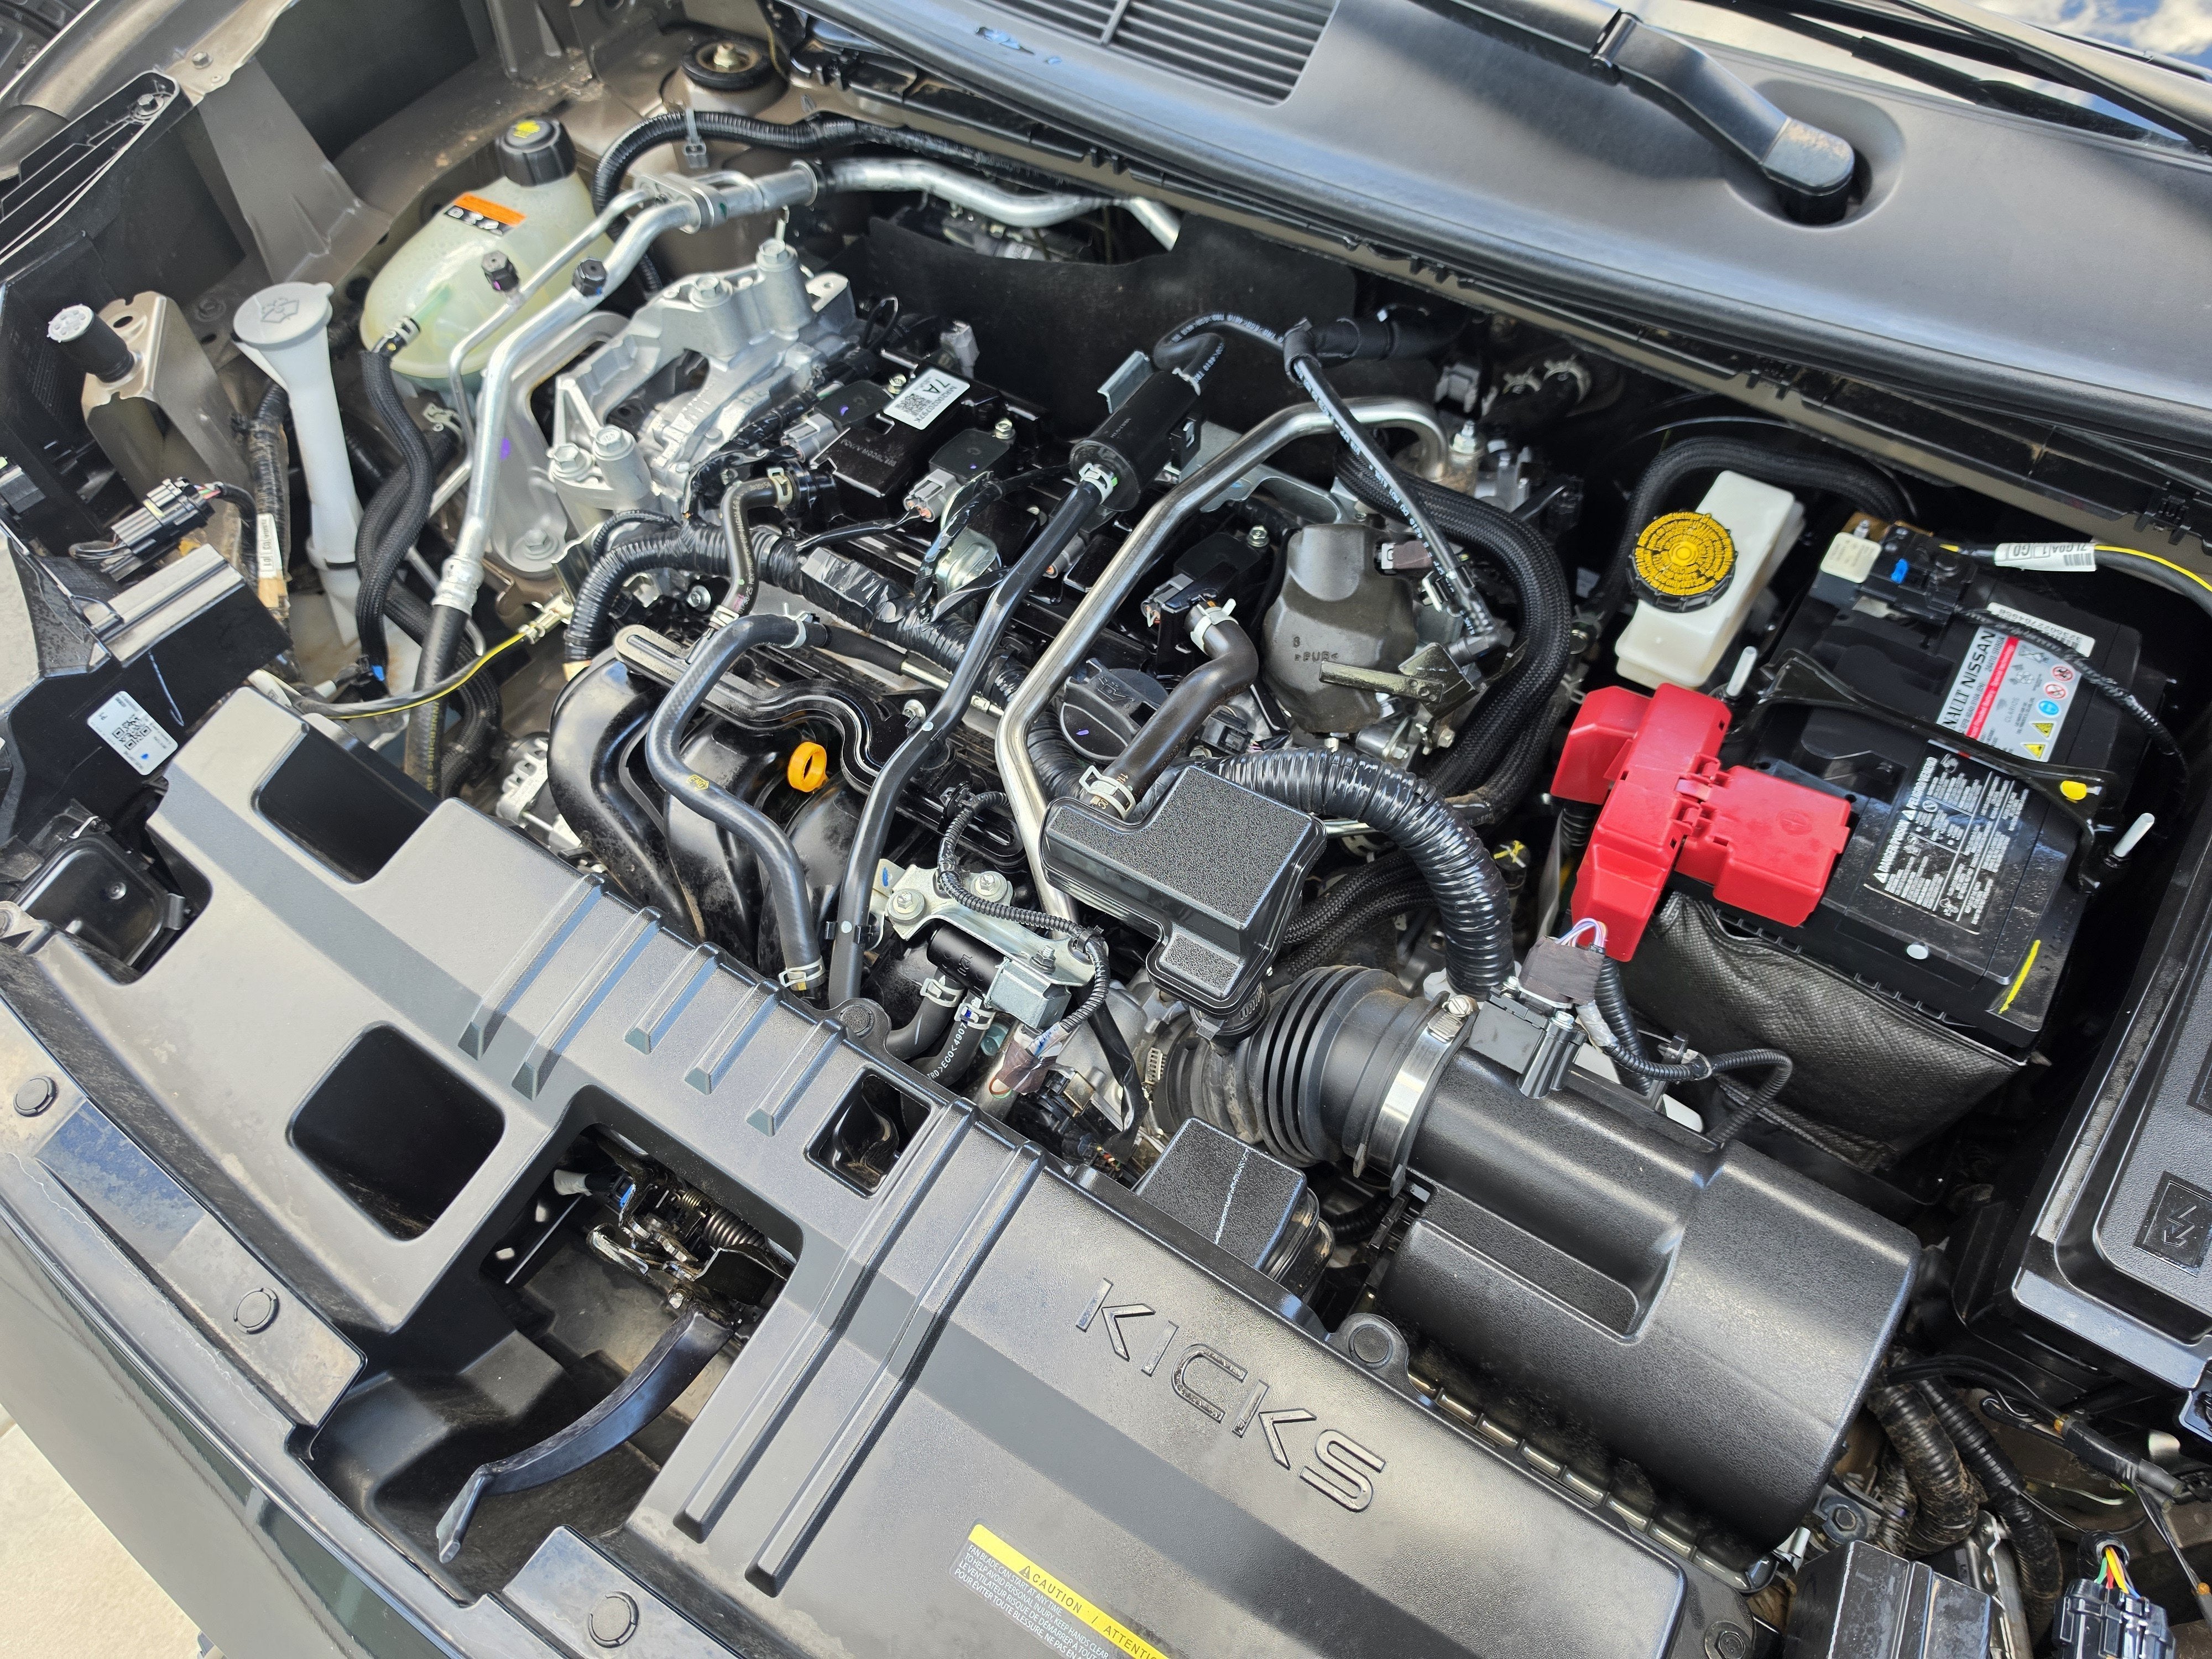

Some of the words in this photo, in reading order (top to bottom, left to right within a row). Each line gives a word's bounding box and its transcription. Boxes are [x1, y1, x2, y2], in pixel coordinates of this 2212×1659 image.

[922, 379, 950, 393] 7A
[1941, 688, 1970, 729] NAULT
[1959, 629, 1996, 688] NISSAN
[1877, 817, 1911, 874] DANGER/POISON
[1075, 1277, 1387, 1513] KICKS
[952, 1567, 974, 1586] POUR
[970, 1580, 995, 1601] ÉVITER
[991, 1594, 1015, 1615] TOUTE
[1011, 1609, 1047, 1637] BLESSURE,
[1044, 1631, 1057, 1645] NE
[1053, 1637, 1069, 1653] PAS
[1066, 1646, 1078, 1659] EN
[957, 1560, 969, 1572] LE
[964, 1565, 1008, 1600] VENTILATEUR
[1004, 1593, 1031, 1615] RISQUE
[1027, 1609, 1040, 1622] DE
[1036, 1616, 1074, 1646] DÉMARRER
[962, 1552, 975, 1565] TO
[970, 1558, 989, 1575] HELP
[985, 1568, 1006, 1587] AVOID
[1003, 1581, 1036, 1608] PERSONAL
[1052, 1616, 1071, 1632] KEEP
[1067, 1626, 1092, 1647] HANDS
[1088, 1640, 1111, 1659] CLEAR
[967, 1545, 982, 1558] FAN
[978, 1553, 999, 1571] BLADE
[997, 1566, 1012, 1580] CAN
[1009, 1574, 1029, 1592] START
[1026, 1586, 1037, 1597] AT
[1034, 1592, 1050, 1606] ANY
[1030, 1572, 1083, 1614] CAUTION
